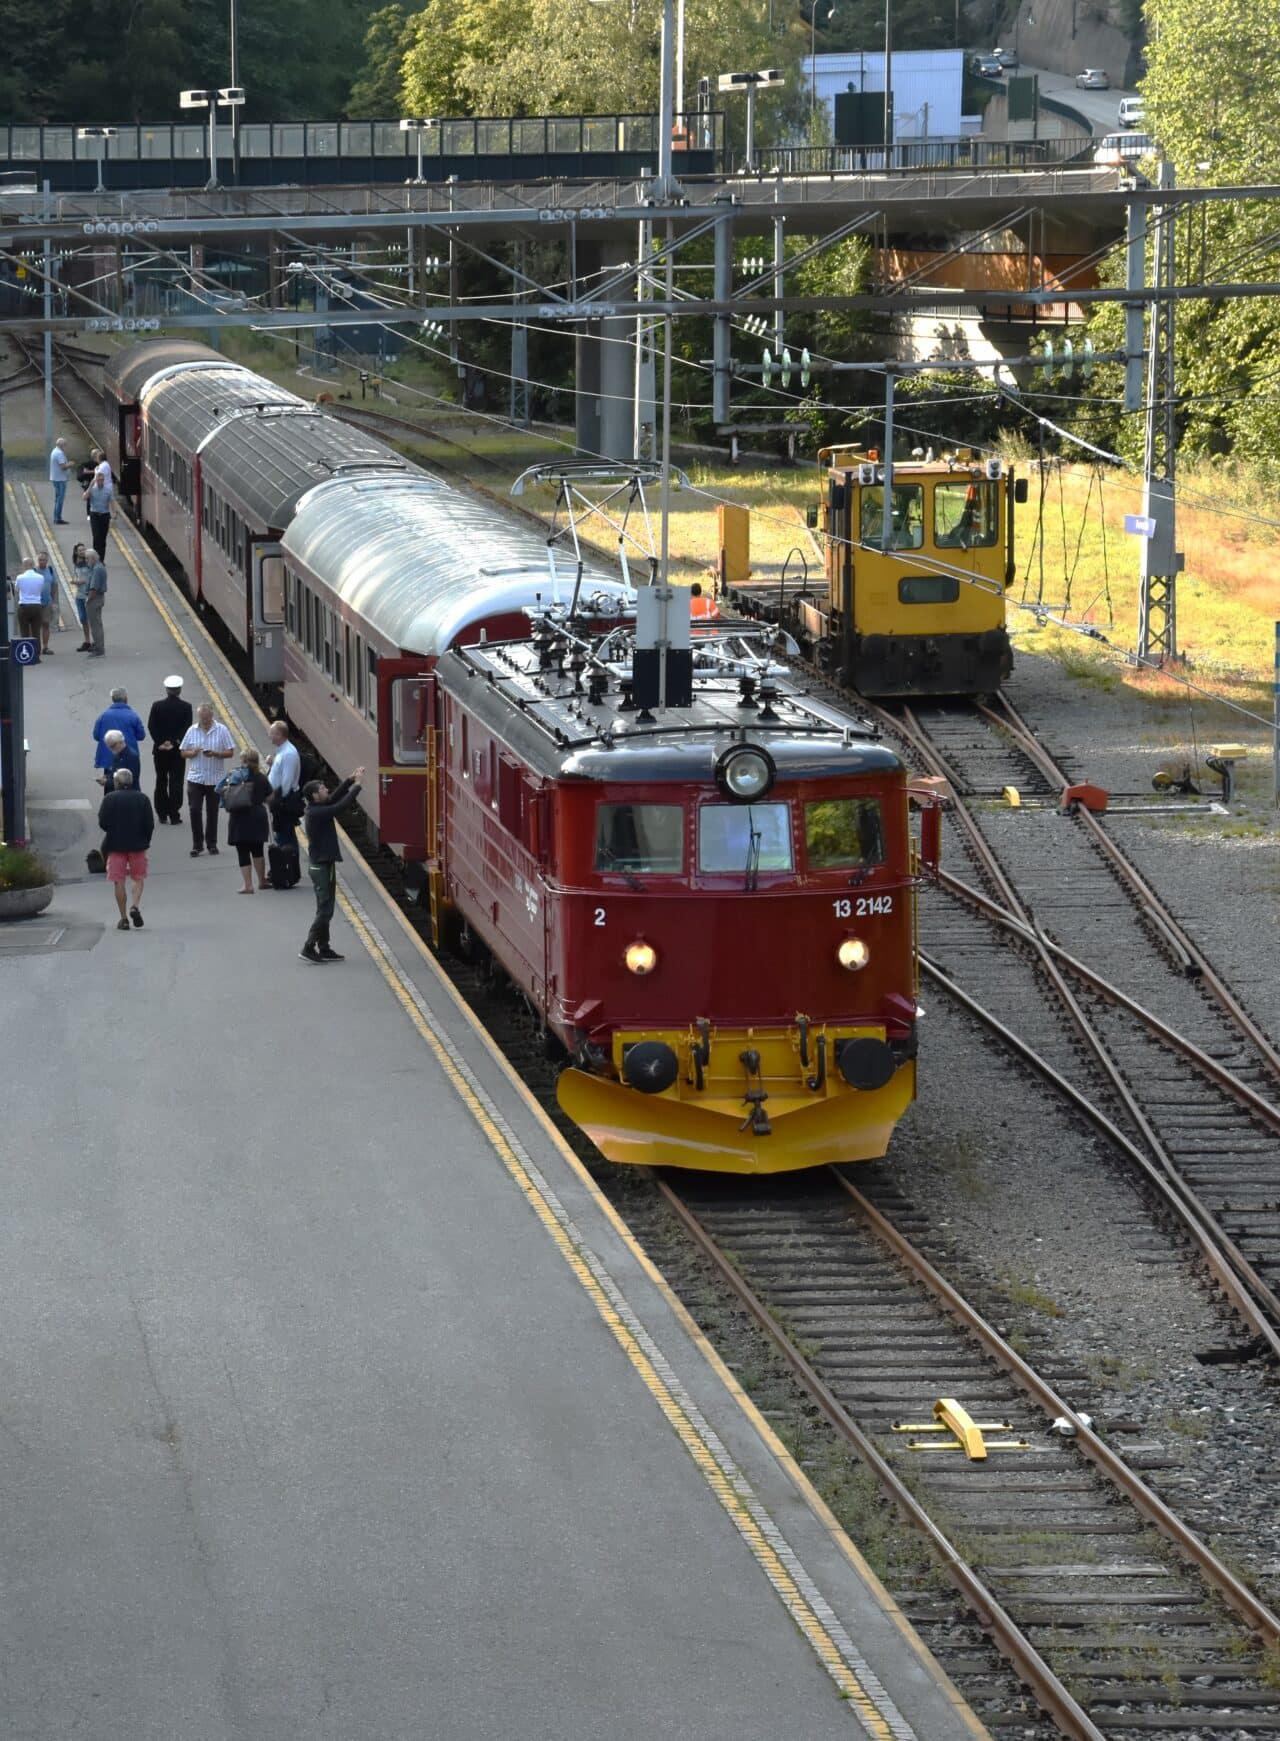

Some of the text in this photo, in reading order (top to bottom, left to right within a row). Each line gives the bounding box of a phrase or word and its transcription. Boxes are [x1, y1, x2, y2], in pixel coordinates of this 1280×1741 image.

[832, 895, 893, 918] 13 2142
[594, 908, 606, 926] 2
